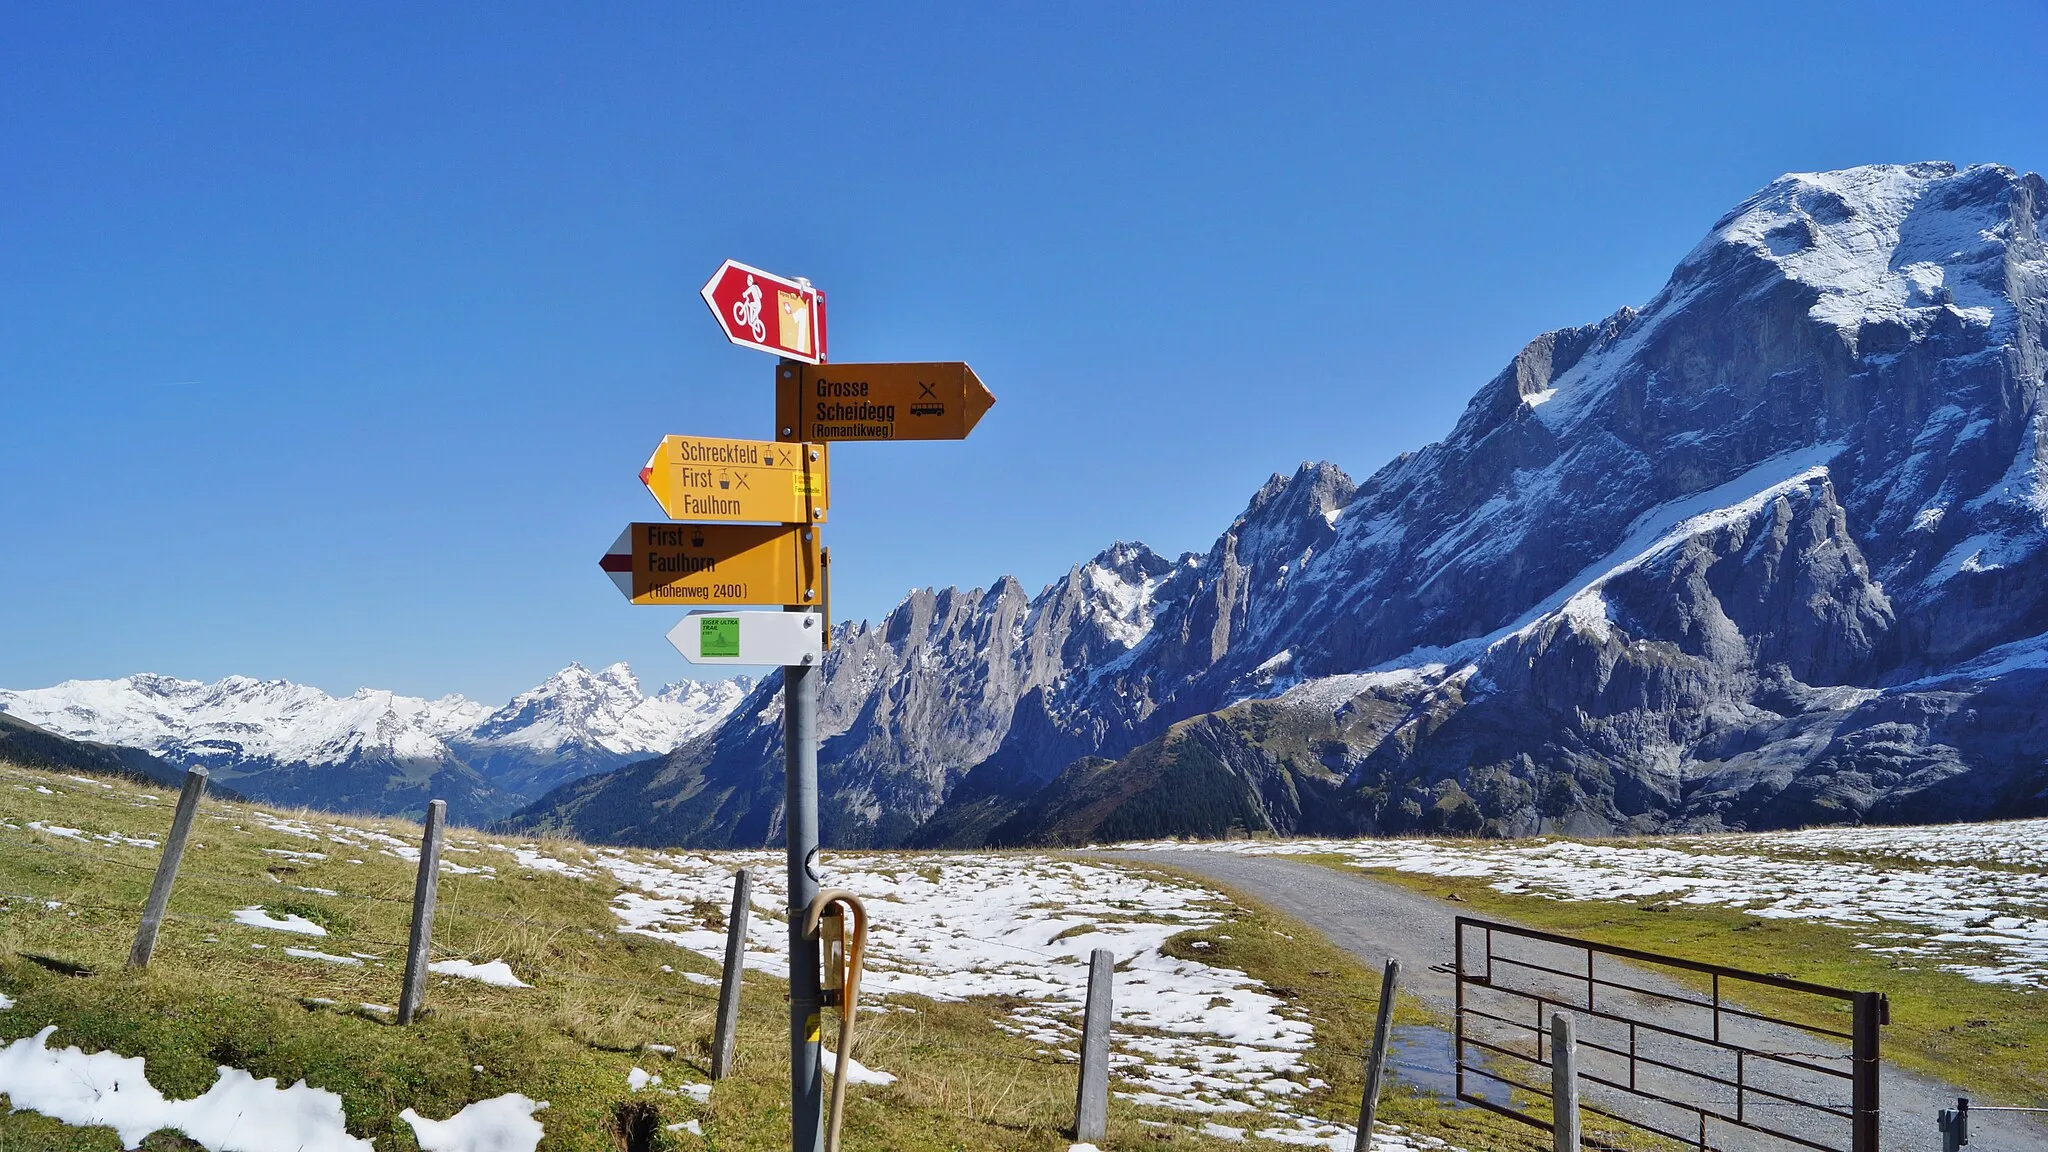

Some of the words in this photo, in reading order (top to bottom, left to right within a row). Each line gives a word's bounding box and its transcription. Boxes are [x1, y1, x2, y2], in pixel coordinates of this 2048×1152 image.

[816, 378, 869, 397] Grosse
[816, 401, 895, 422] Scheidegg
[811, 422, 894, 438] (Romantikweg)
[681, 440, 758, 464] Schreckfeld
[682, 467, 713, 488] First
[684, 494, 741, 515] Faulhorn
[648, 526, 684, 546] First
[648, 552, 715, 572] Faulhorn
[713, 583, 747, 599] 2400)
